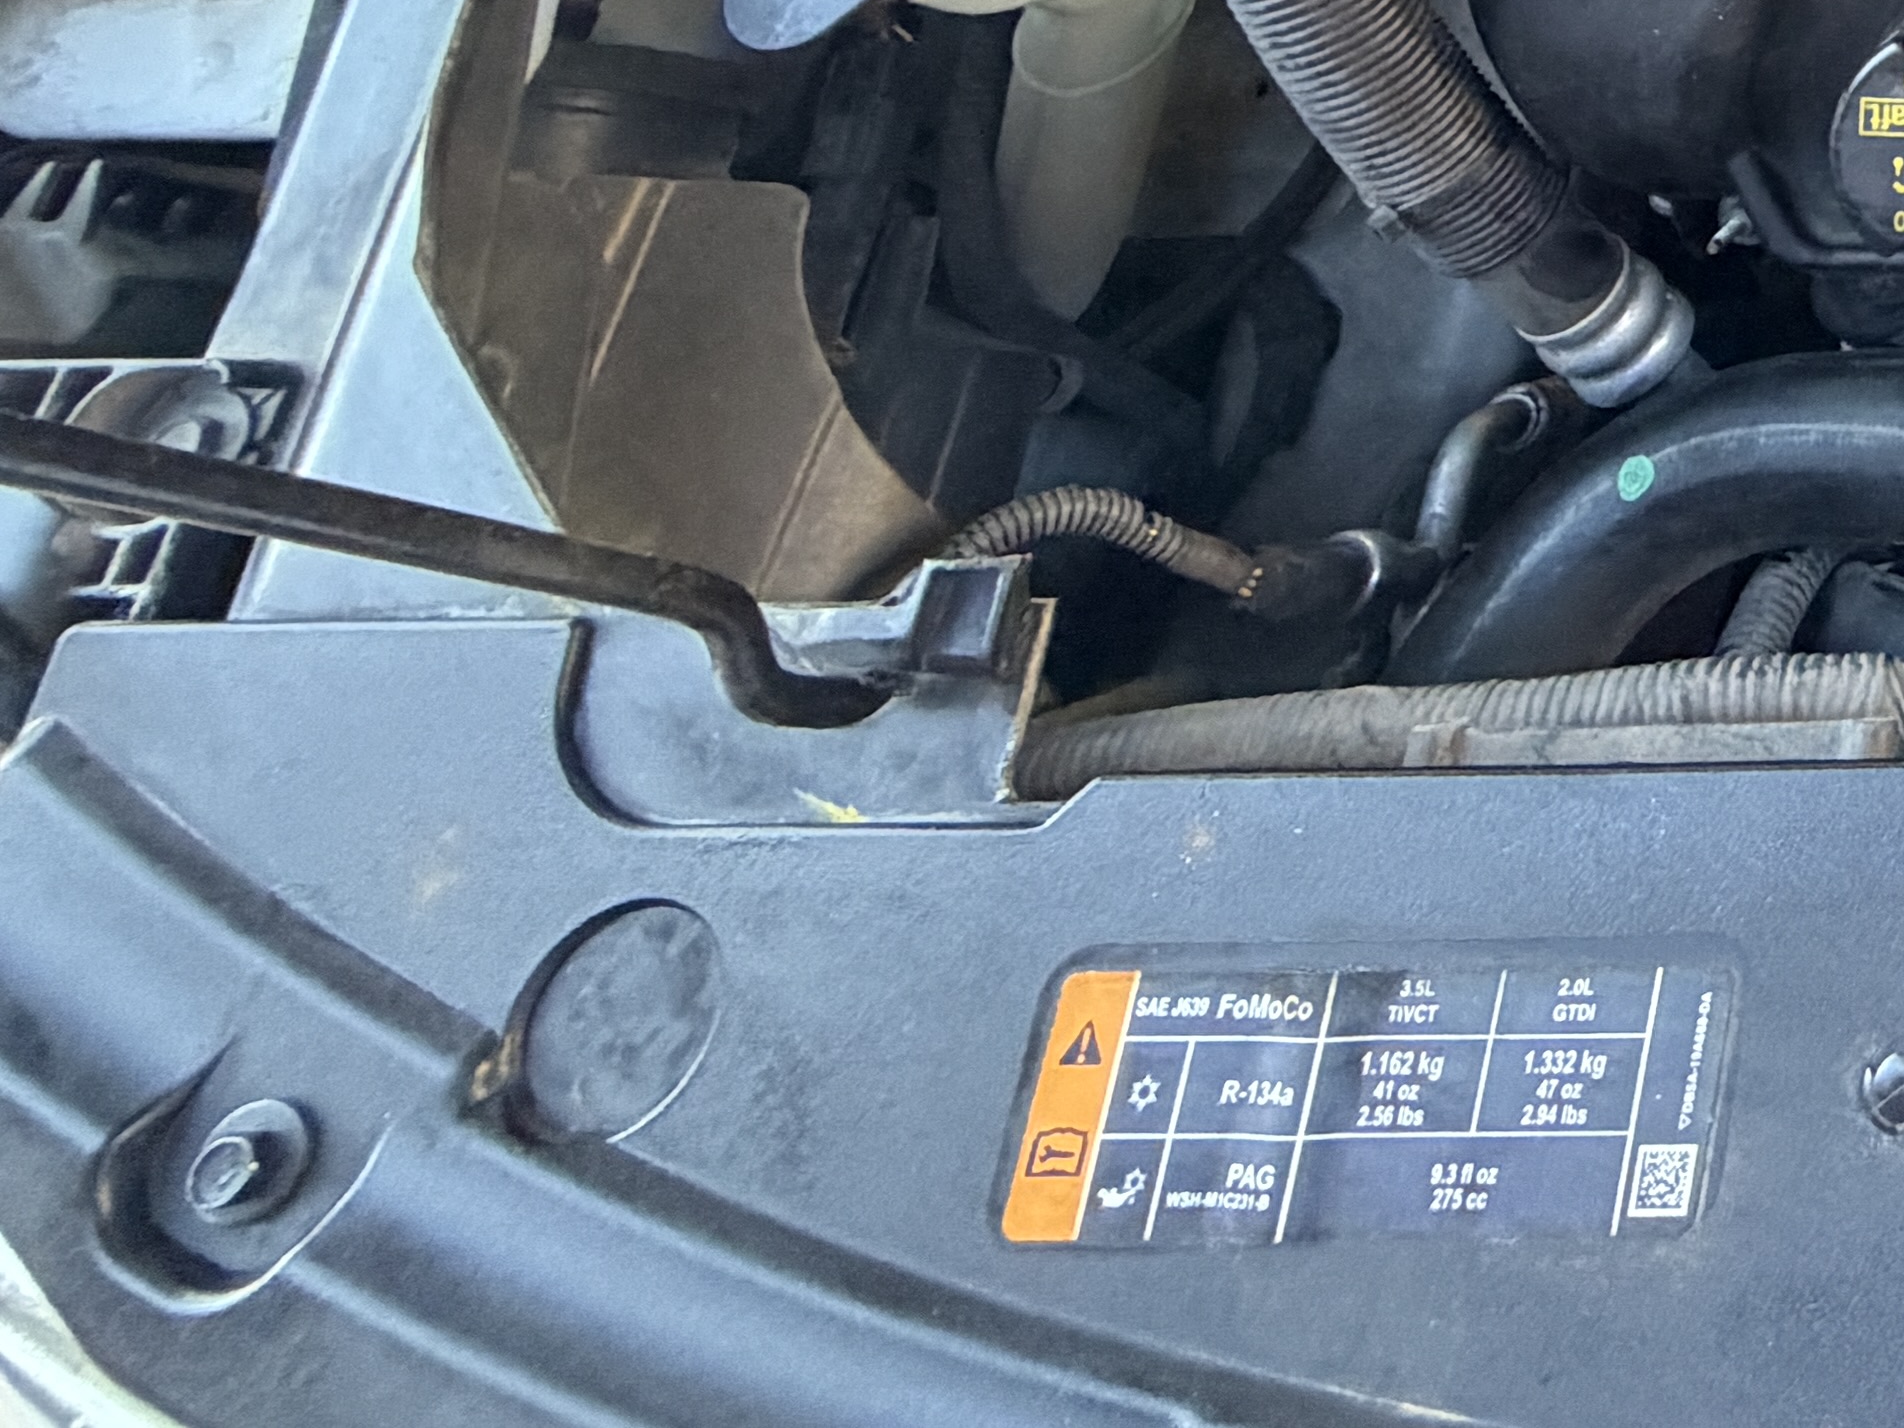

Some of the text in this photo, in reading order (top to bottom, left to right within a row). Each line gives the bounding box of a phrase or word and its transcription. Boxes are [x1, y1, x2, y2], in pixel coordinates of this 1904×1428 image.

[1400, 979, 1435, 998] 3.5L
[1558, 978, 1594, 997] 2.0L
[1135, 994, 1314, 1021] SAE J639 FoMoCo
[1552, 1003, 1596, 1022] GTDI
[1360, 1051, 1445, 1081] 1.162 kg
[1524, 1050, 1607, 1080] 1.332 kg
[1219, 1080, 1295, 1107] R-134a
[1373, 1081, 1420, 1100] 41 oz
[1535, 1080, 1583, 1099] 47 oz
[1356, 1106, 1424, 1127] 2.56 lbs
[1520, 1105, 1587, 1126] 2.94 lbs
[1226, 1163, 1276, 1191] PAG
[1430, 1163, 1498, 1185] 9.3 fl oz
[1429, 1189, 1488, 1210] 275 cc
